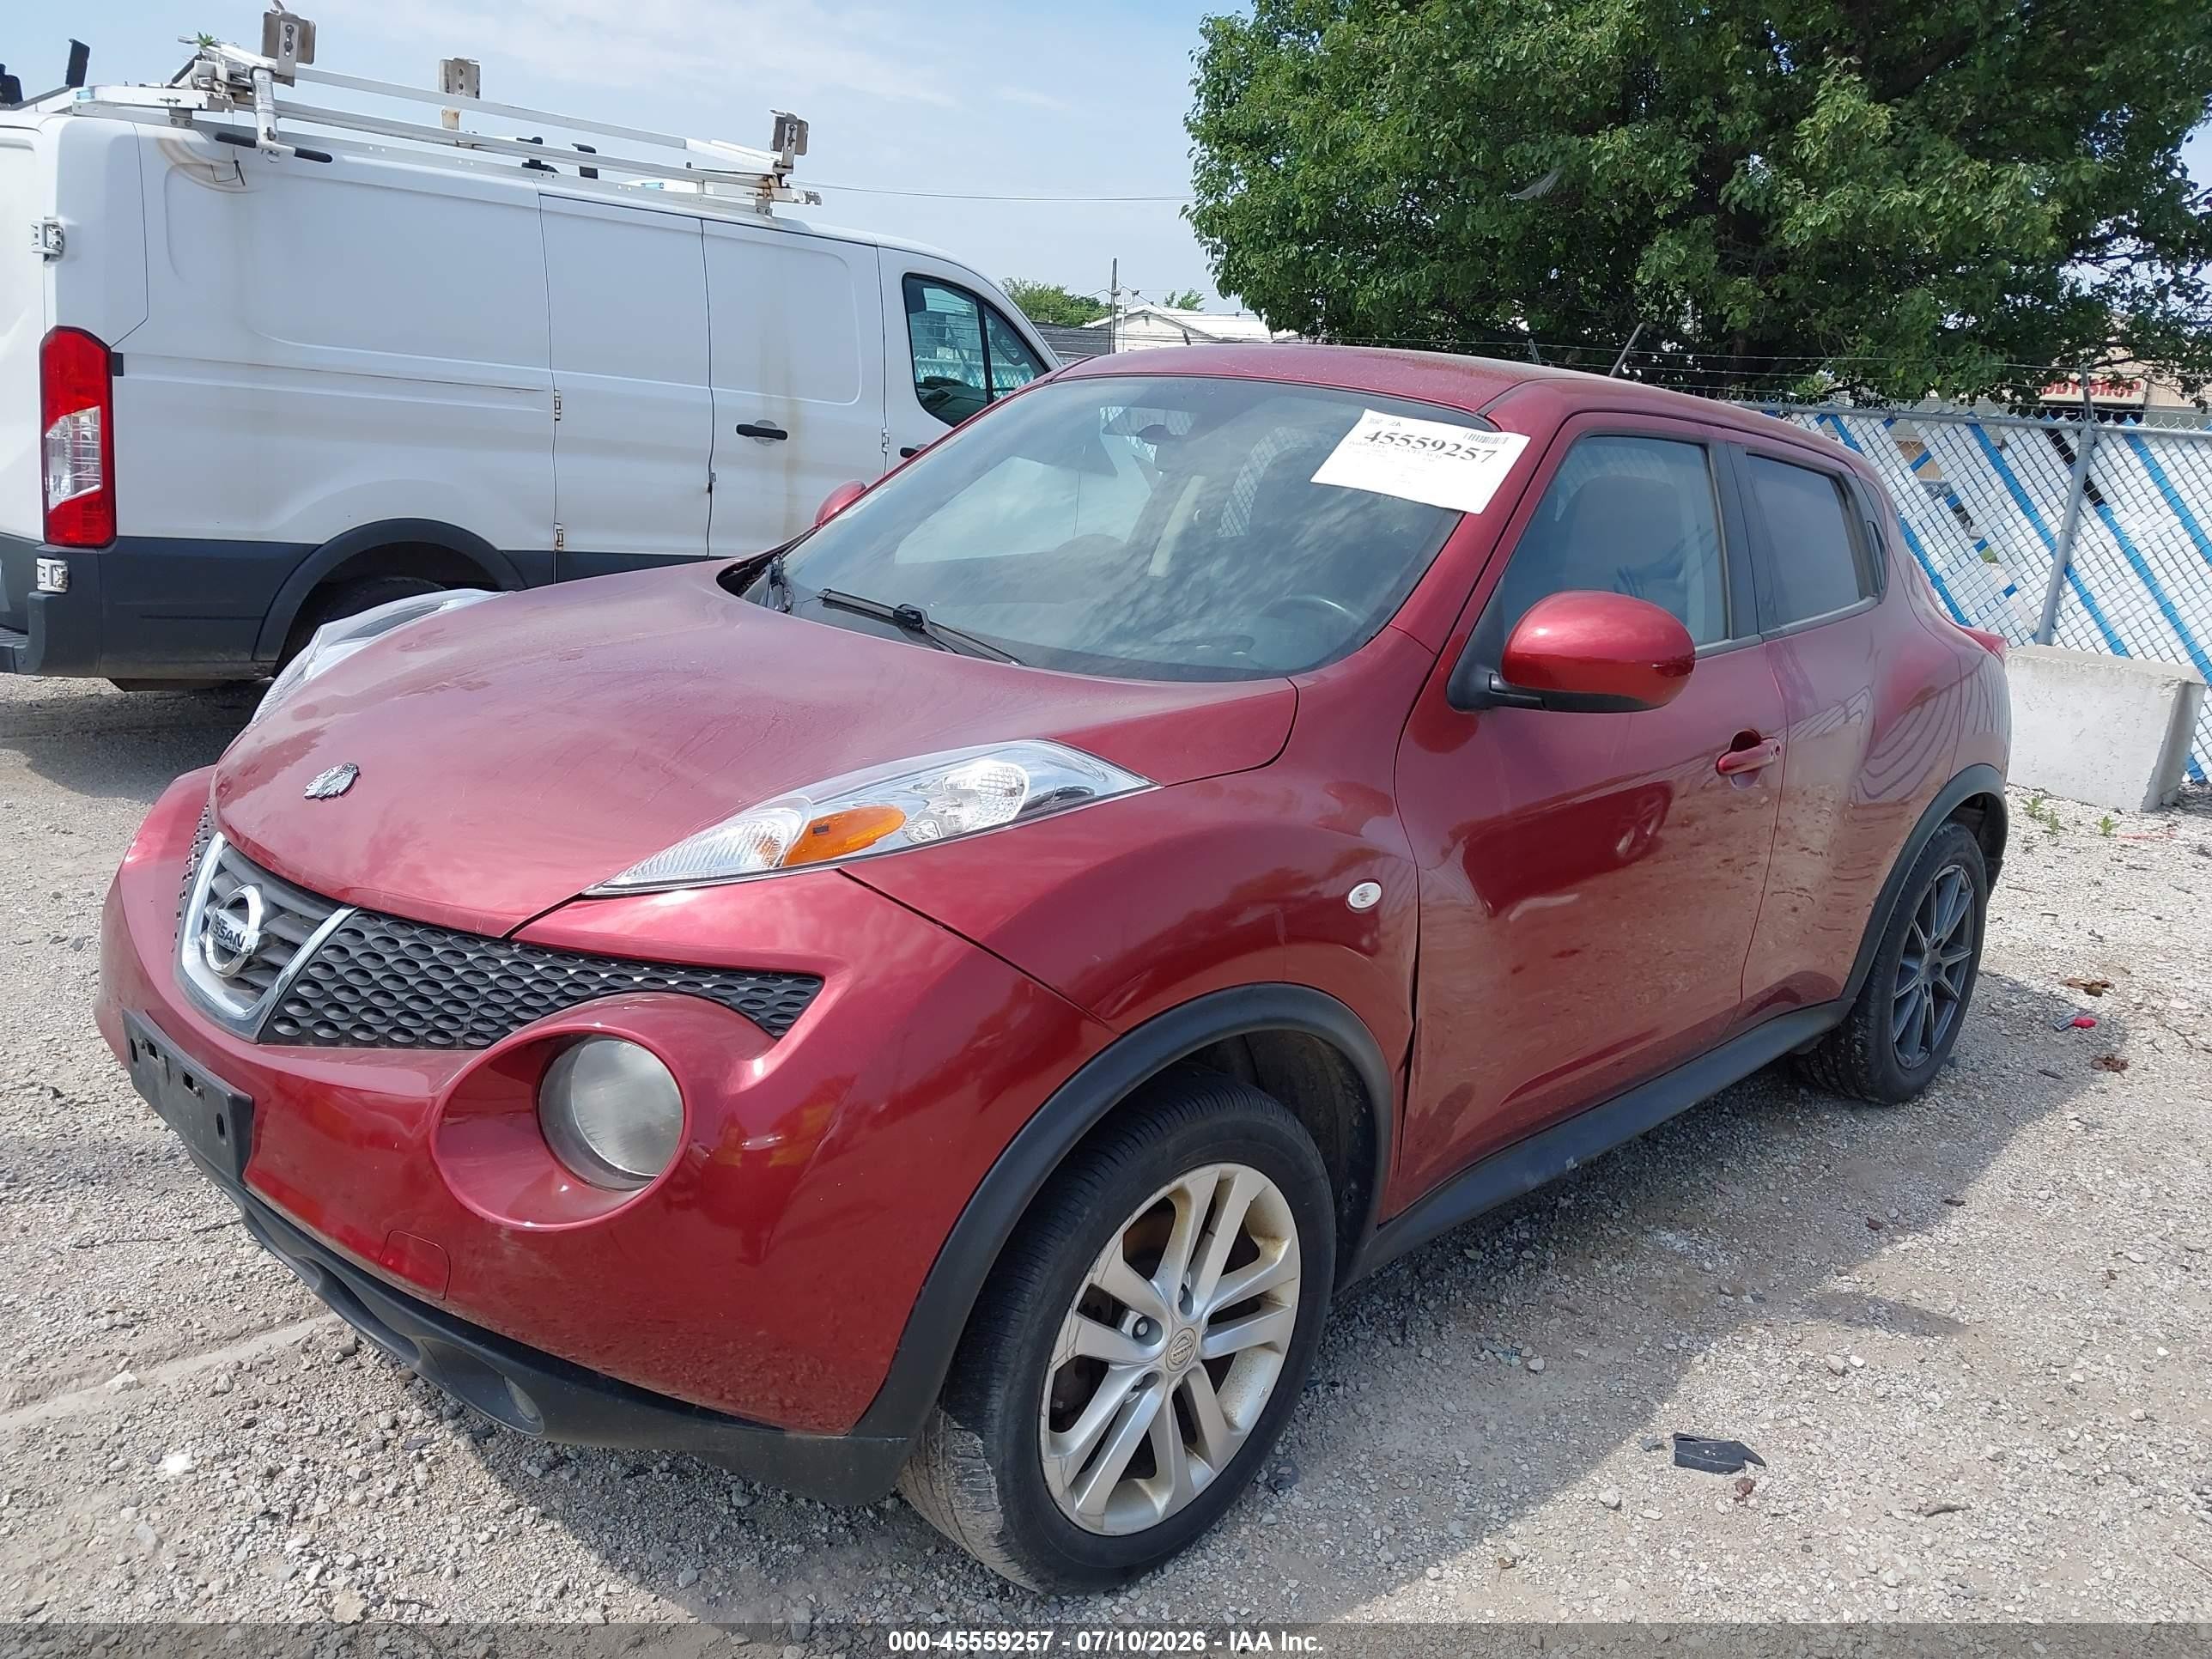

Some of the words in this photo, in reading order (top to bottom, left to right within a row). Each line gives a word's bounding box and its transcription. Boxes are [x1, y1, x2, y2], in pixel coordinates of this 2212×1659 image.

[2040, 378, 2081, 396] ODY
[1364, 430, 1498, 464] 45559257
[210, 918, 246, 949] ISSAN
